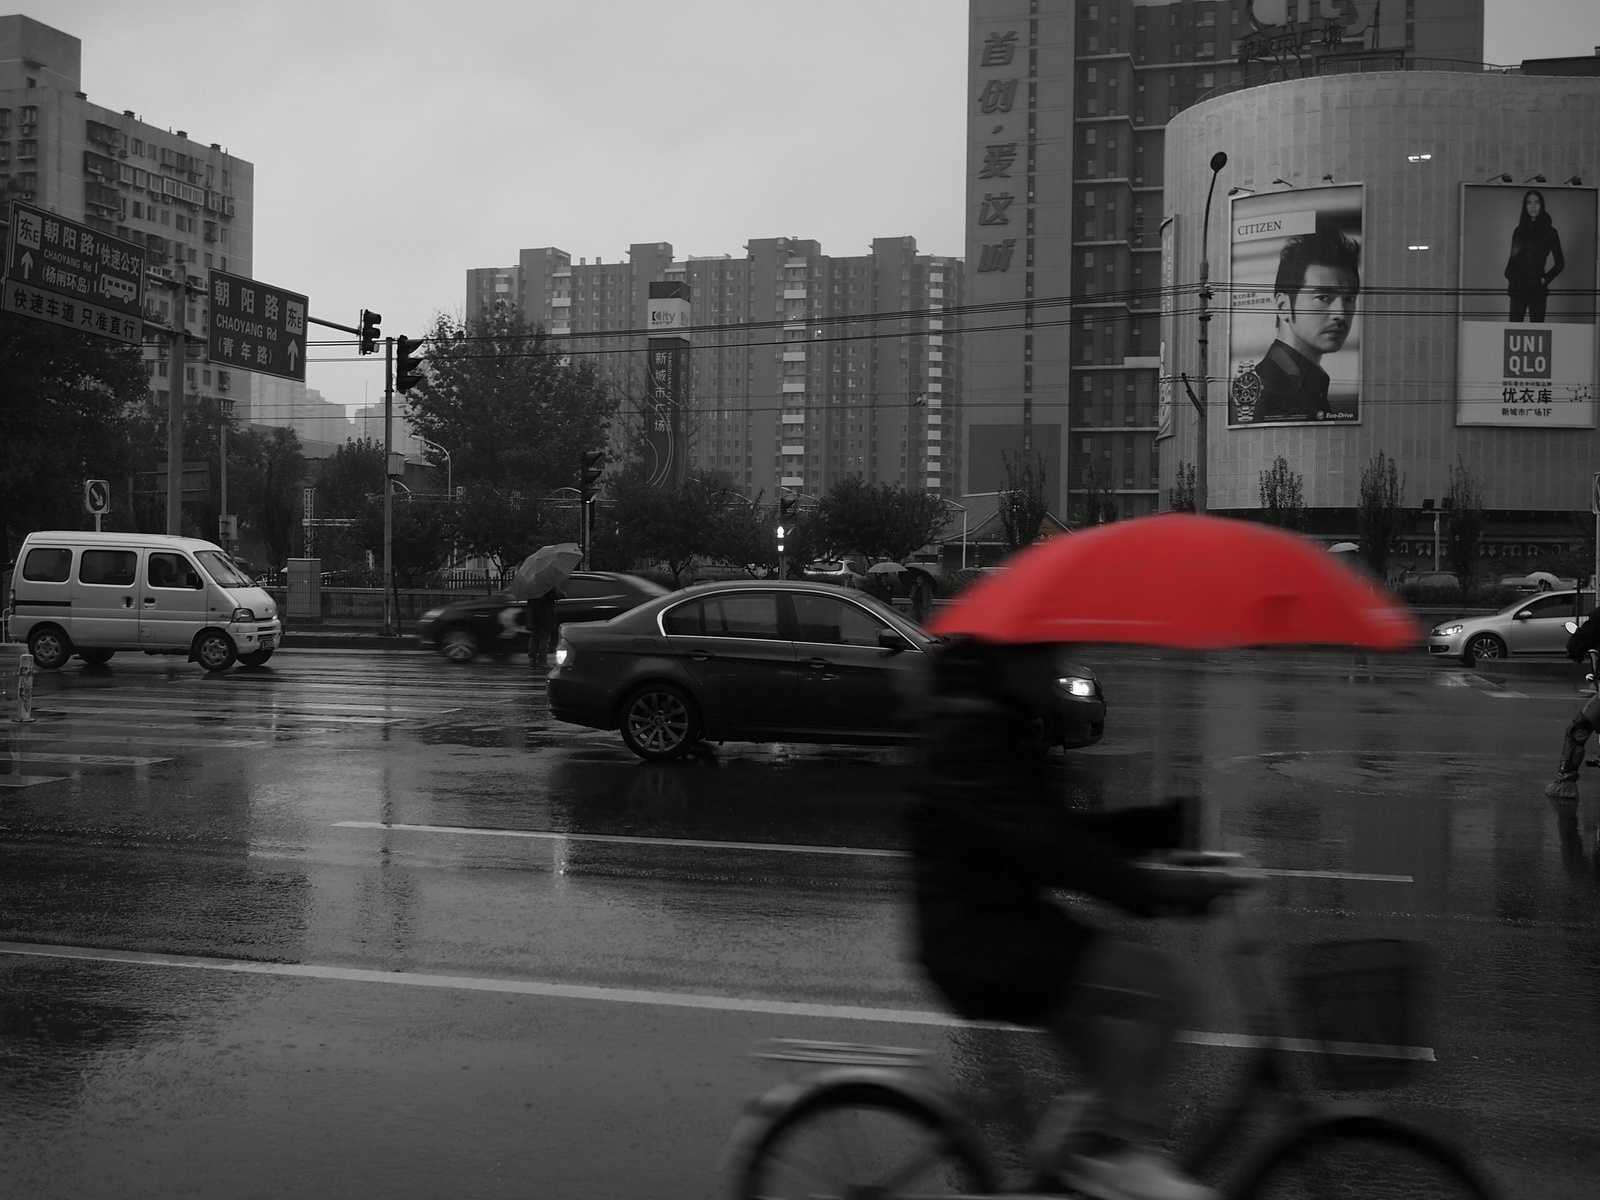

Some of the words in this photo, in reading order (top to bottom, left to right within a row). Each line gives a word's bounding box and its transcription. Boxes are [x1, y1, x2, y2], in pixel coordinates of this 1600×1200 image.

[1237, 219, 1282, 236] CITIZEN
[44, 219, 94, 256] 朝阳路
[102, 243, 140, 276] 快速公交
[214, 279, 279, 321] 朝阳路
[15, 288, 74, 323] 快速车道
[81, 307, 135, 339] 只准直行
[216, 313, 263, 338] CHAOYANG
[266, 326, 278, 341] Rd
[1509, 335, 1543, 353] UNI
[1509, 355, 1546, 375] QLO
[1502, 387, 1552, 404] 优衣库
